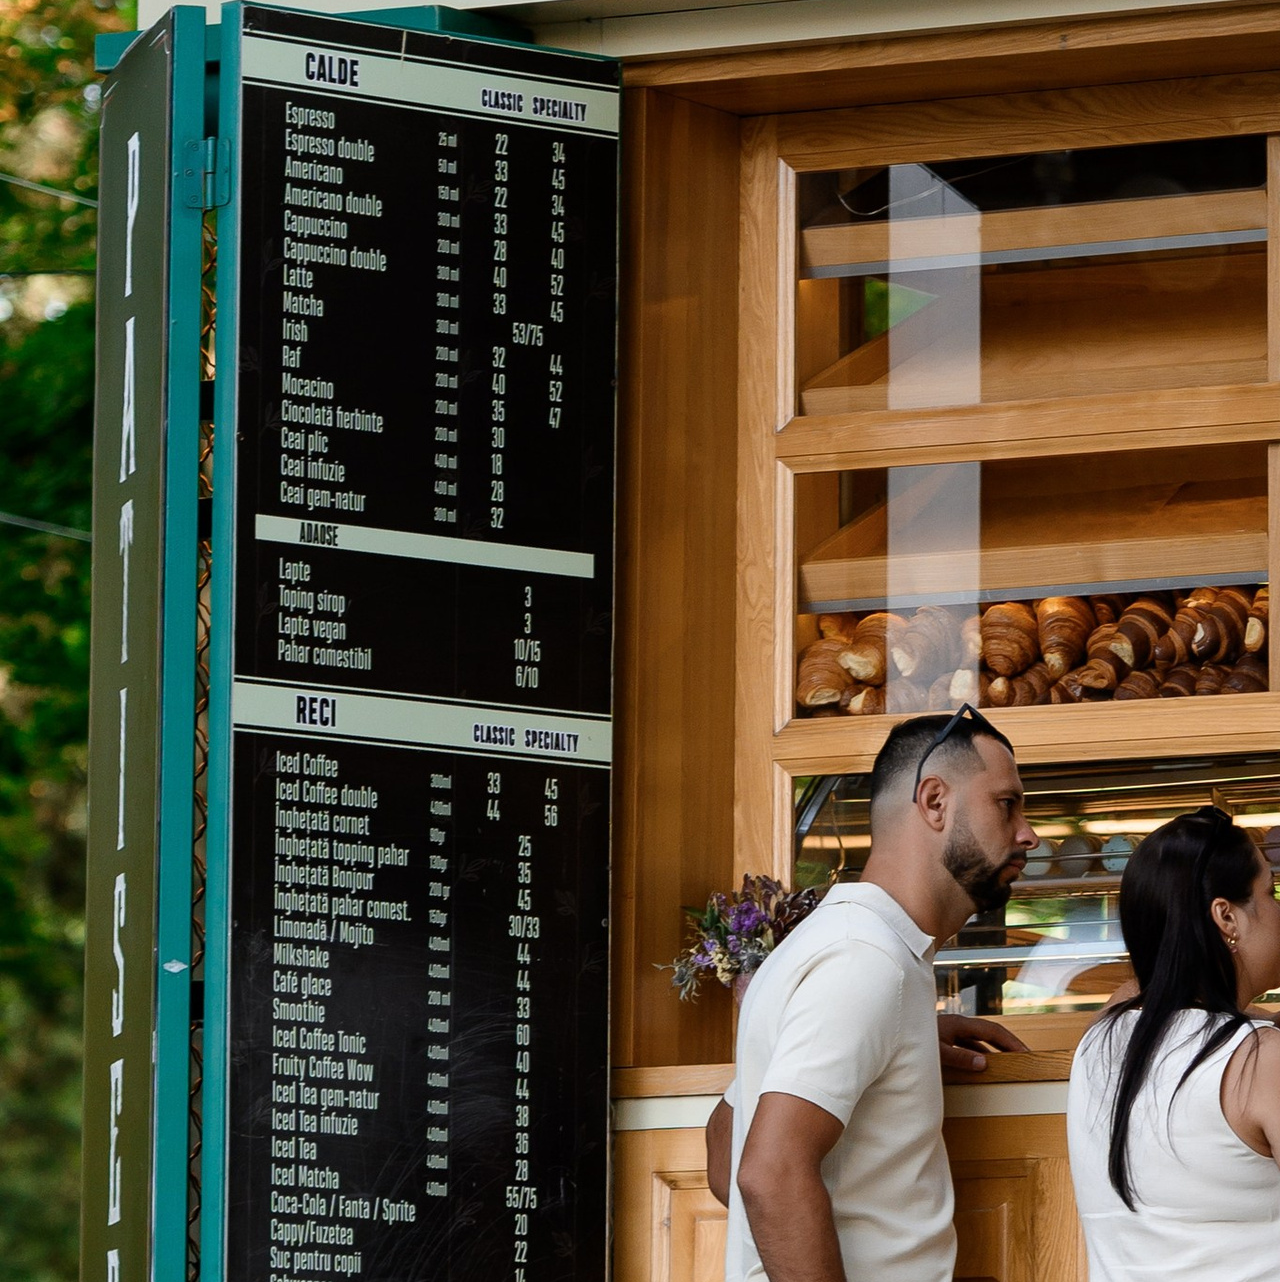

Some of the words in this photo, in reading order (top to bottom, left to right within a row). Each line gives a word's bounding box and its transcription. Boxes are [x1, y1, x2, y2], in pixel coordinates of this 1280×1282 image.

[305, 52, 359, 87] CALDE
[285, 101, 335, 130] Espresso
[482, 89, 524, 113] CLASSIC
[533, 96, 588, 122] SPECIALTY
[285, 128, 335, 157] Espresso
[337, 136, 375, 163] double
[495, 133, 508, 156] 22
[552, 141, 566, 164] 34
[284, 155, 343, 185] Americano
[494, 159, 508, 182] 33
[551, 168, 565, 190] 45
[284, 182, 343, 212] Americano
[345, 191, 383, 218] double
[494, 186, 508, 209] 22
[284, 209, 348, 240] Cappuccino
[494, 212, 507, 235] 33
[283, 236, 347, 267] Cappuccino
[350, 245, 387, 272] double
[493, 239, 507, 262] 28
[551, 247, 564, 270] 40
[283, 263, 314, 289] Latte
[493, 266, 507, 288] 40
[283, 290, 324, 317] Matcha
[493, 292, 506, 315] 33
[282, 317, 308, 343] Irish
[512, 322, 543, 347] 53/75
[282, 345, 302, 369] Raf
[492, 346, 506, 369] 32
[282, 372, 334, 400] Mocacino
[492, 373, 506, 395] 40
[549, 380, 563, 403] 52
[336, 405, 384, 433] fierbinte
[492, 399, 505, 422] 35
[548, 407, 562, 429] 47
[281, 426, 305, 451] Ceai
[307, 430, 329, 456] plic
[491, 426, 505, 449] 30
[280, 453, 305, 478] Ceai
[307, 457, 345, 483] infuzie
[491, 453, 503, 475] 18
[280, 480, 304, 505] Ceai
[307, 488, 366, 512] gem-natur
[490, 480, 504, 502] 28
[490, 506, 504, 529] 32
[300, 522, 338, 547] ADAOSE
[279, 557, 311, 585] Lapte
[278, 584, 314, 615] Toping
[317, 589, 346, 618] sirop
[524, 585, 532, 607] 3
[278, 611, 310, 640] Lapte
[312, 619, 346, 644] vegan
[524, 612, 532, 634] 3
[278, 638, 311, 664] Pahar
[312, 647, 372, 671] comestibil
[513, 638, 541, 662] 10/15
[515, 665, 539, 689] 6/10
[296, 695, 337, 727] RECI
[473, 723, 516, 747] CLASSIC
[525, 729, 579, 753] SPECIALTY
[276, 750, 300, 774] Iced
[302, 753, 338, 778] Coffee
[487, 771, 501, 794] 33
[544, 777, 558, 800] 45
[332, 814, 370, 836] cornet
[518, 835, 532, 857] 25
[332, 865, 375, 895] Bonjour
[508, 914, 540, 939] 30/33
[273, 942, 330, 969] Milkshake
[300, 972, 332, 1000] glace
[272, 997, 326, 1024] Smoothie
[272, 1024, 297, 1049] Iced
[299, 1027, 335, 1052] Coffee
[337, 1030, 367, 1055] Tonic
[516, 1023, 530, 1046] 60
[272, 1052, 307, 1082] Fruity
[308, 1055, 345, 1080] Coffee
[346, 1058, 374, 1082] Wow
[272, 1079, 296, 1104] Iced
[298, 1081, 318, 1106] Tea
[320, 1087, 380, 1111] gem-natur
[271, 1162, 296, 1187] Iced
[298, 1164, 340, 1190] Matcha
[506, 1185, 537, 1209] 55/75
[270, 1218, 354, 1247] Cappy/Fuzetea
[270, 1245, 291, 1269] Suc
[293, 1250, 332, 1275] pentru
[334, 1251, 362, 1278] copii
